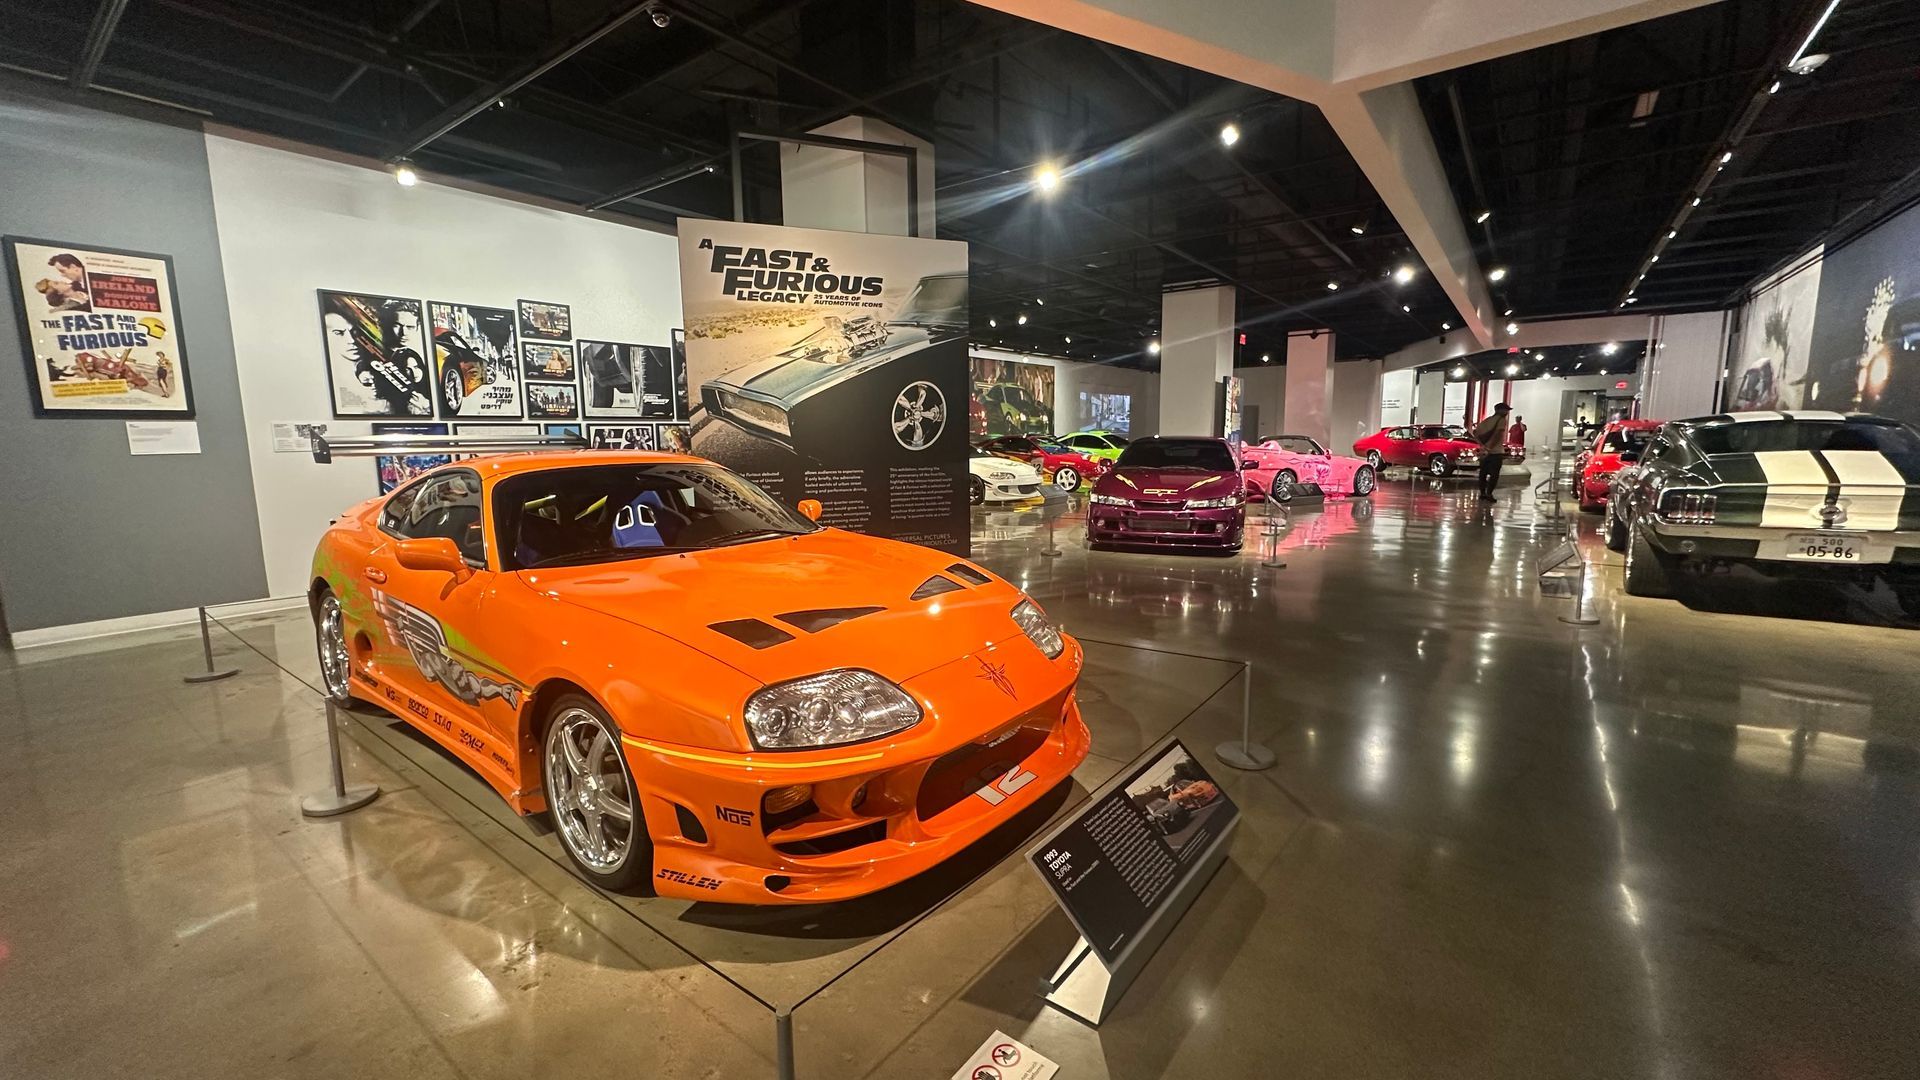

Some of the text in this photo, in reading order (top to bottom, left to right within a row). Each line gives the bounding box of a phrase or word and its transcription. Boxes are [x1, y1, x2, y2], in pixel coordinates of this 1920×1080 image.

[698, 238, 713, 250] A
[710, 245, 830, 273] FAST &
[91, 280, 156, 294] IRELAND
[722, 268, 883, 296] FURIOUS
[96, 298, 158, 310] MALONE
[737, 290, 809, 304] LEGACY
[41, 314, 136, 332] THE FAST AND
[118, 323, 137, 331] THE
[57, 332, 148, 350] FURIOUS
[1822, 538, 1844, 546] 500
[716, 805, 755, 826] NOS
[1044, 849, 1059, 863] 1993
[1049, 851, 1072, 871] TOYOTA
[656, 868, 723, 891] STILLEN
[1055, 863, 1072, 880] SUPRA
